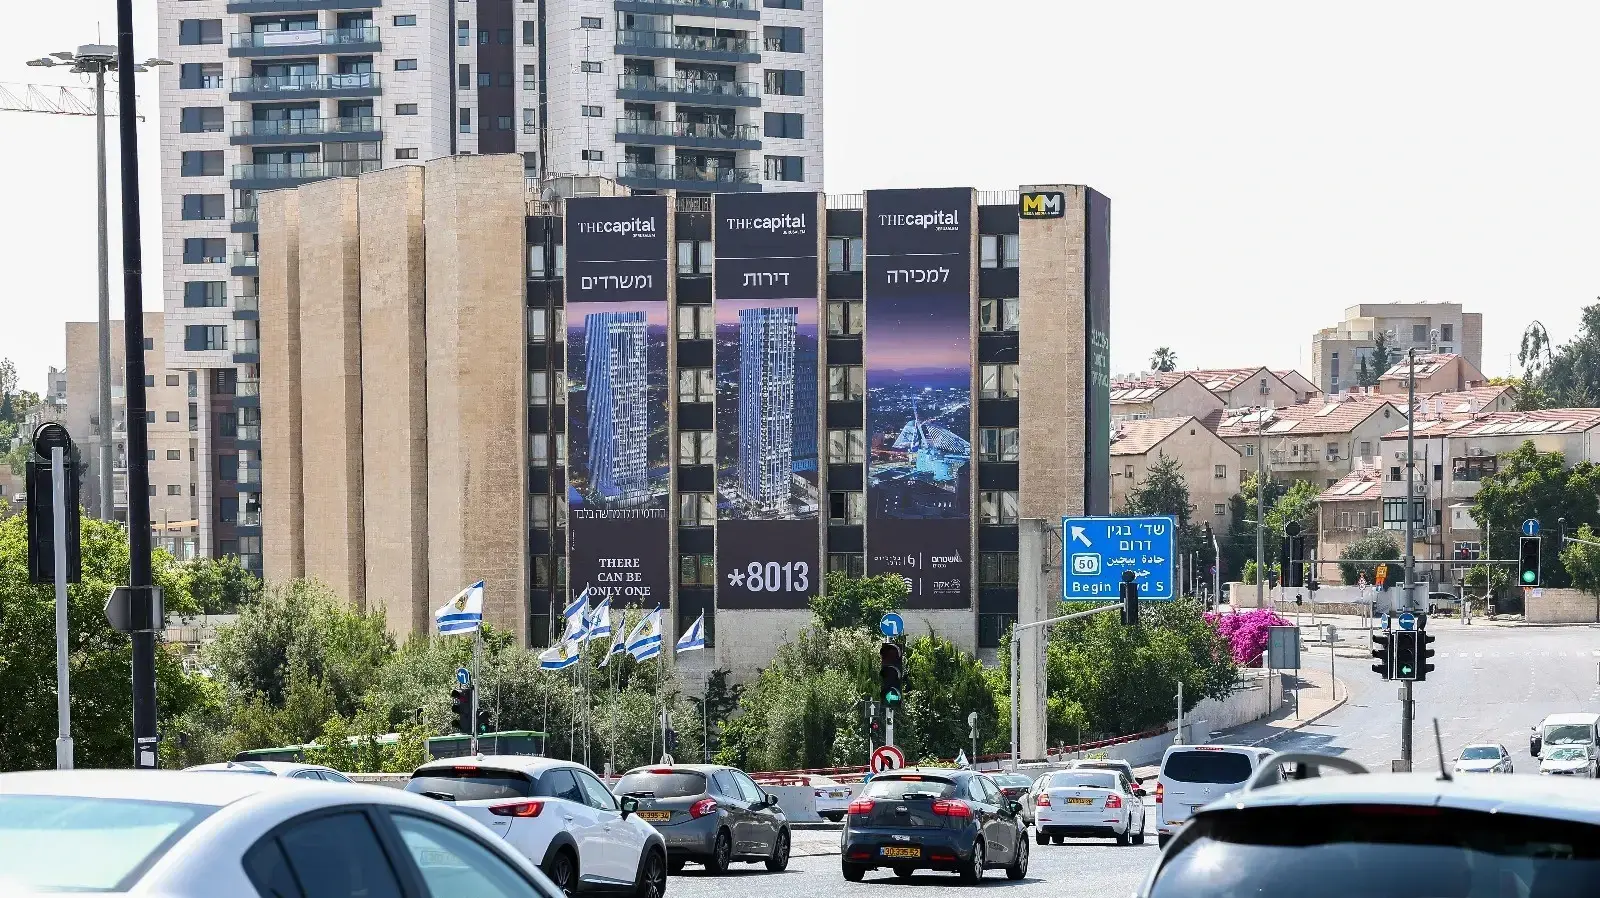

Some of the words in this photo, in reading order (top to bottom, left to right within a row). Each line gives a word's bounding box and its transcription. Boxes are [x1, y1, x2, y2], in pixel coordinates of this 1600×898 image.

[743, 272, 790, 286] דירות
[886, 266, 950, 284] למכירה
[581, 275, 652, 289] ומשרדים
[573, 507, 594, 519] בלבד
[1106, 525, 1132, 539] בגין
[1119, 540, 1152, 551] דרום
[598, 558, 640, 568] THERE
[1078, 559, 1094, 570] 50
[1141, 555, 1165, 566] جادة
[597, 572, 623, 582] CAN
[626, 572, 642, 582] BE
[589, 586, 623, 596] ONLY
[625, 586, 651, 596] ONE
[933, 581, 950, 590] אקה
[1072, 581, 1111, 594] Begin
[1156, 581, 1164, 592] S
